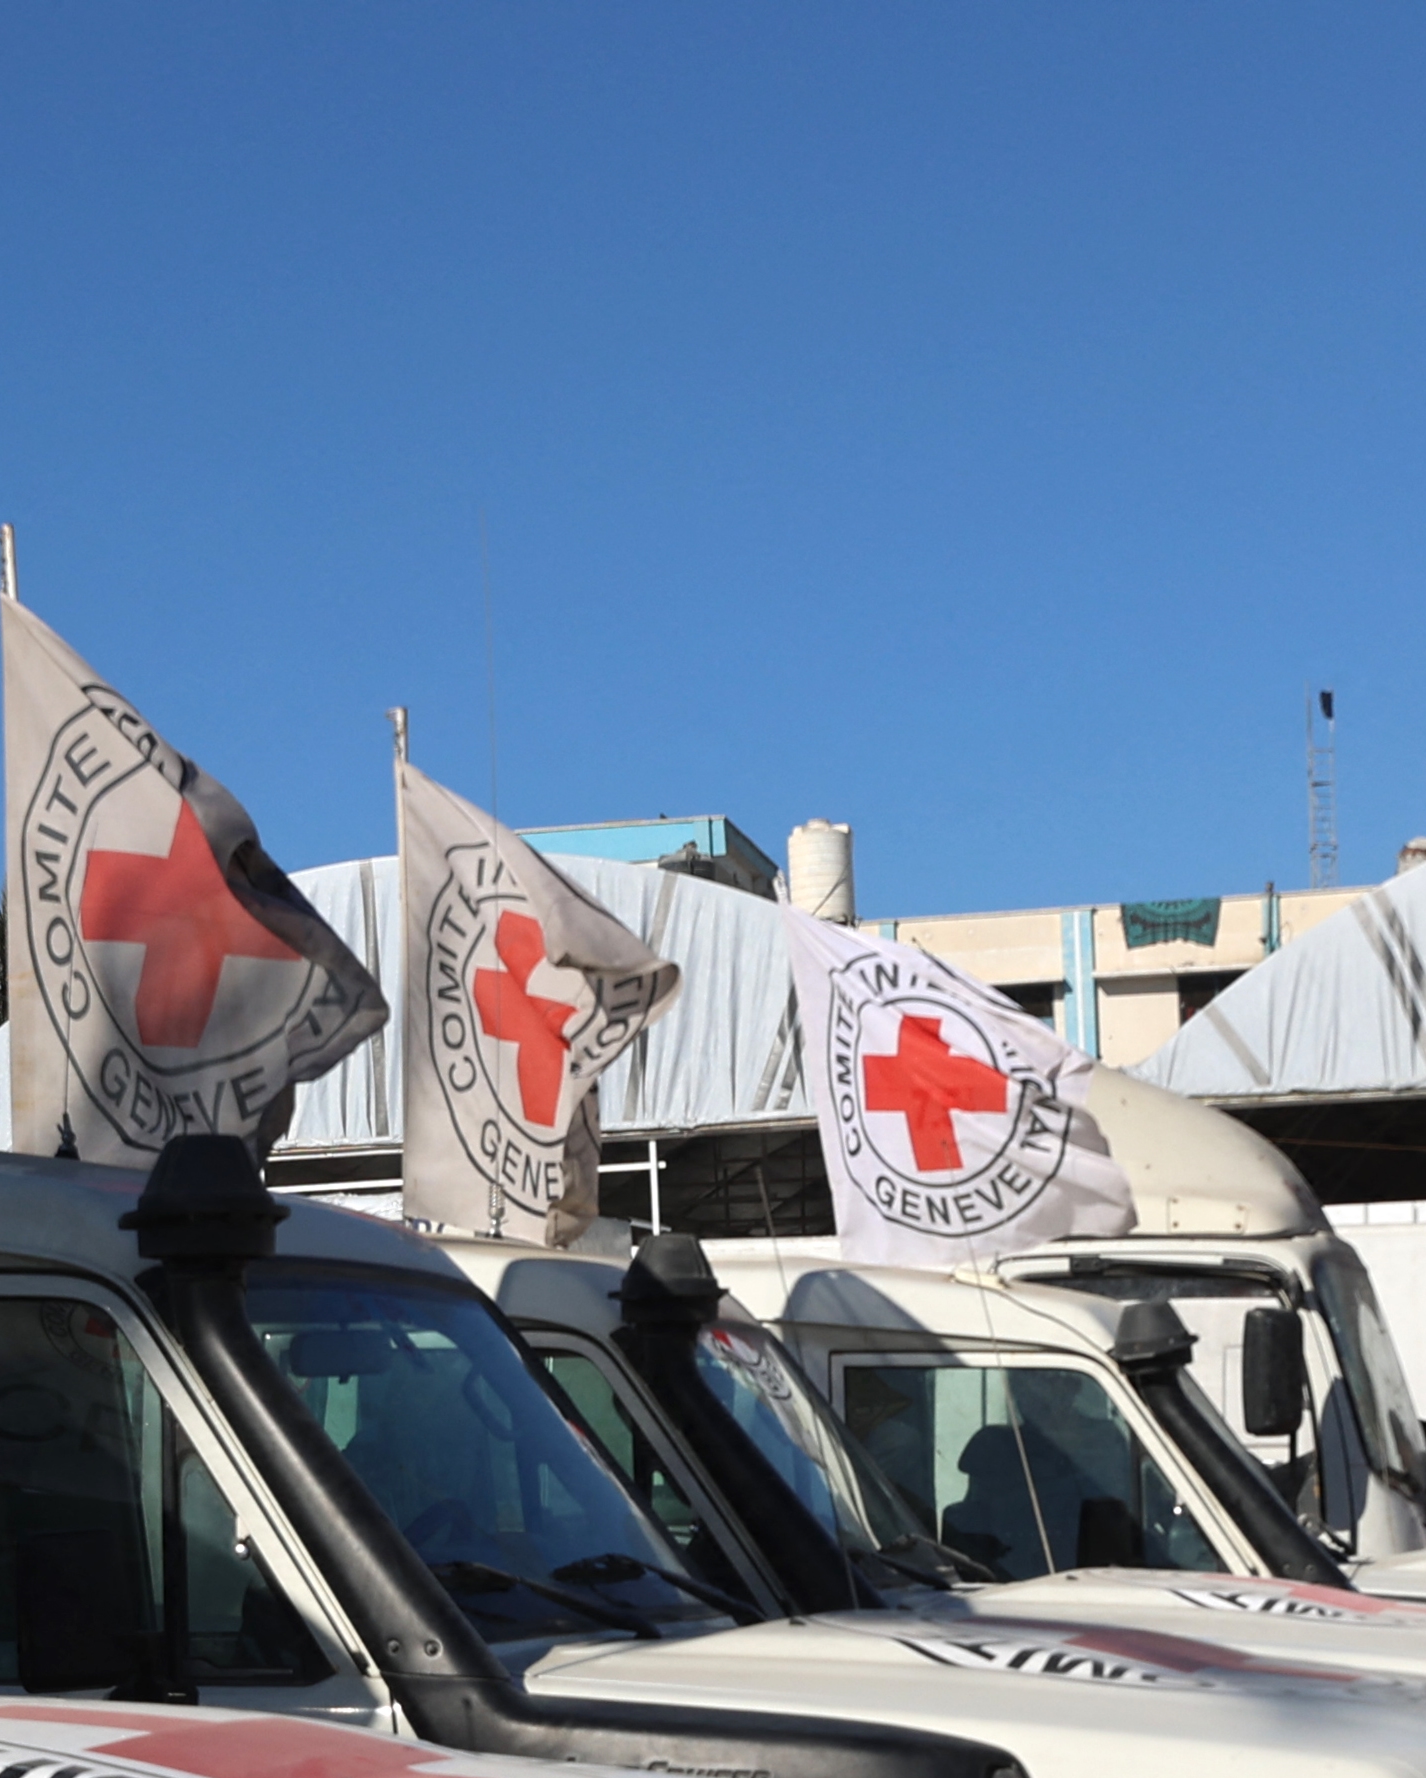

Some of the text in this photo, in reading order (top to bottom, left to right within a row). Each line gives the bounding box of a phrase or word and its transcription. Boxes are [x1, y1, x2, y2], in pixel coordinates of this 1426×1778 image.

[33, 729, 114, 1021] COMITE
[480, 1118, 566, 1200] GENE
[874, 1162, 1032, 1226] GENEVE
